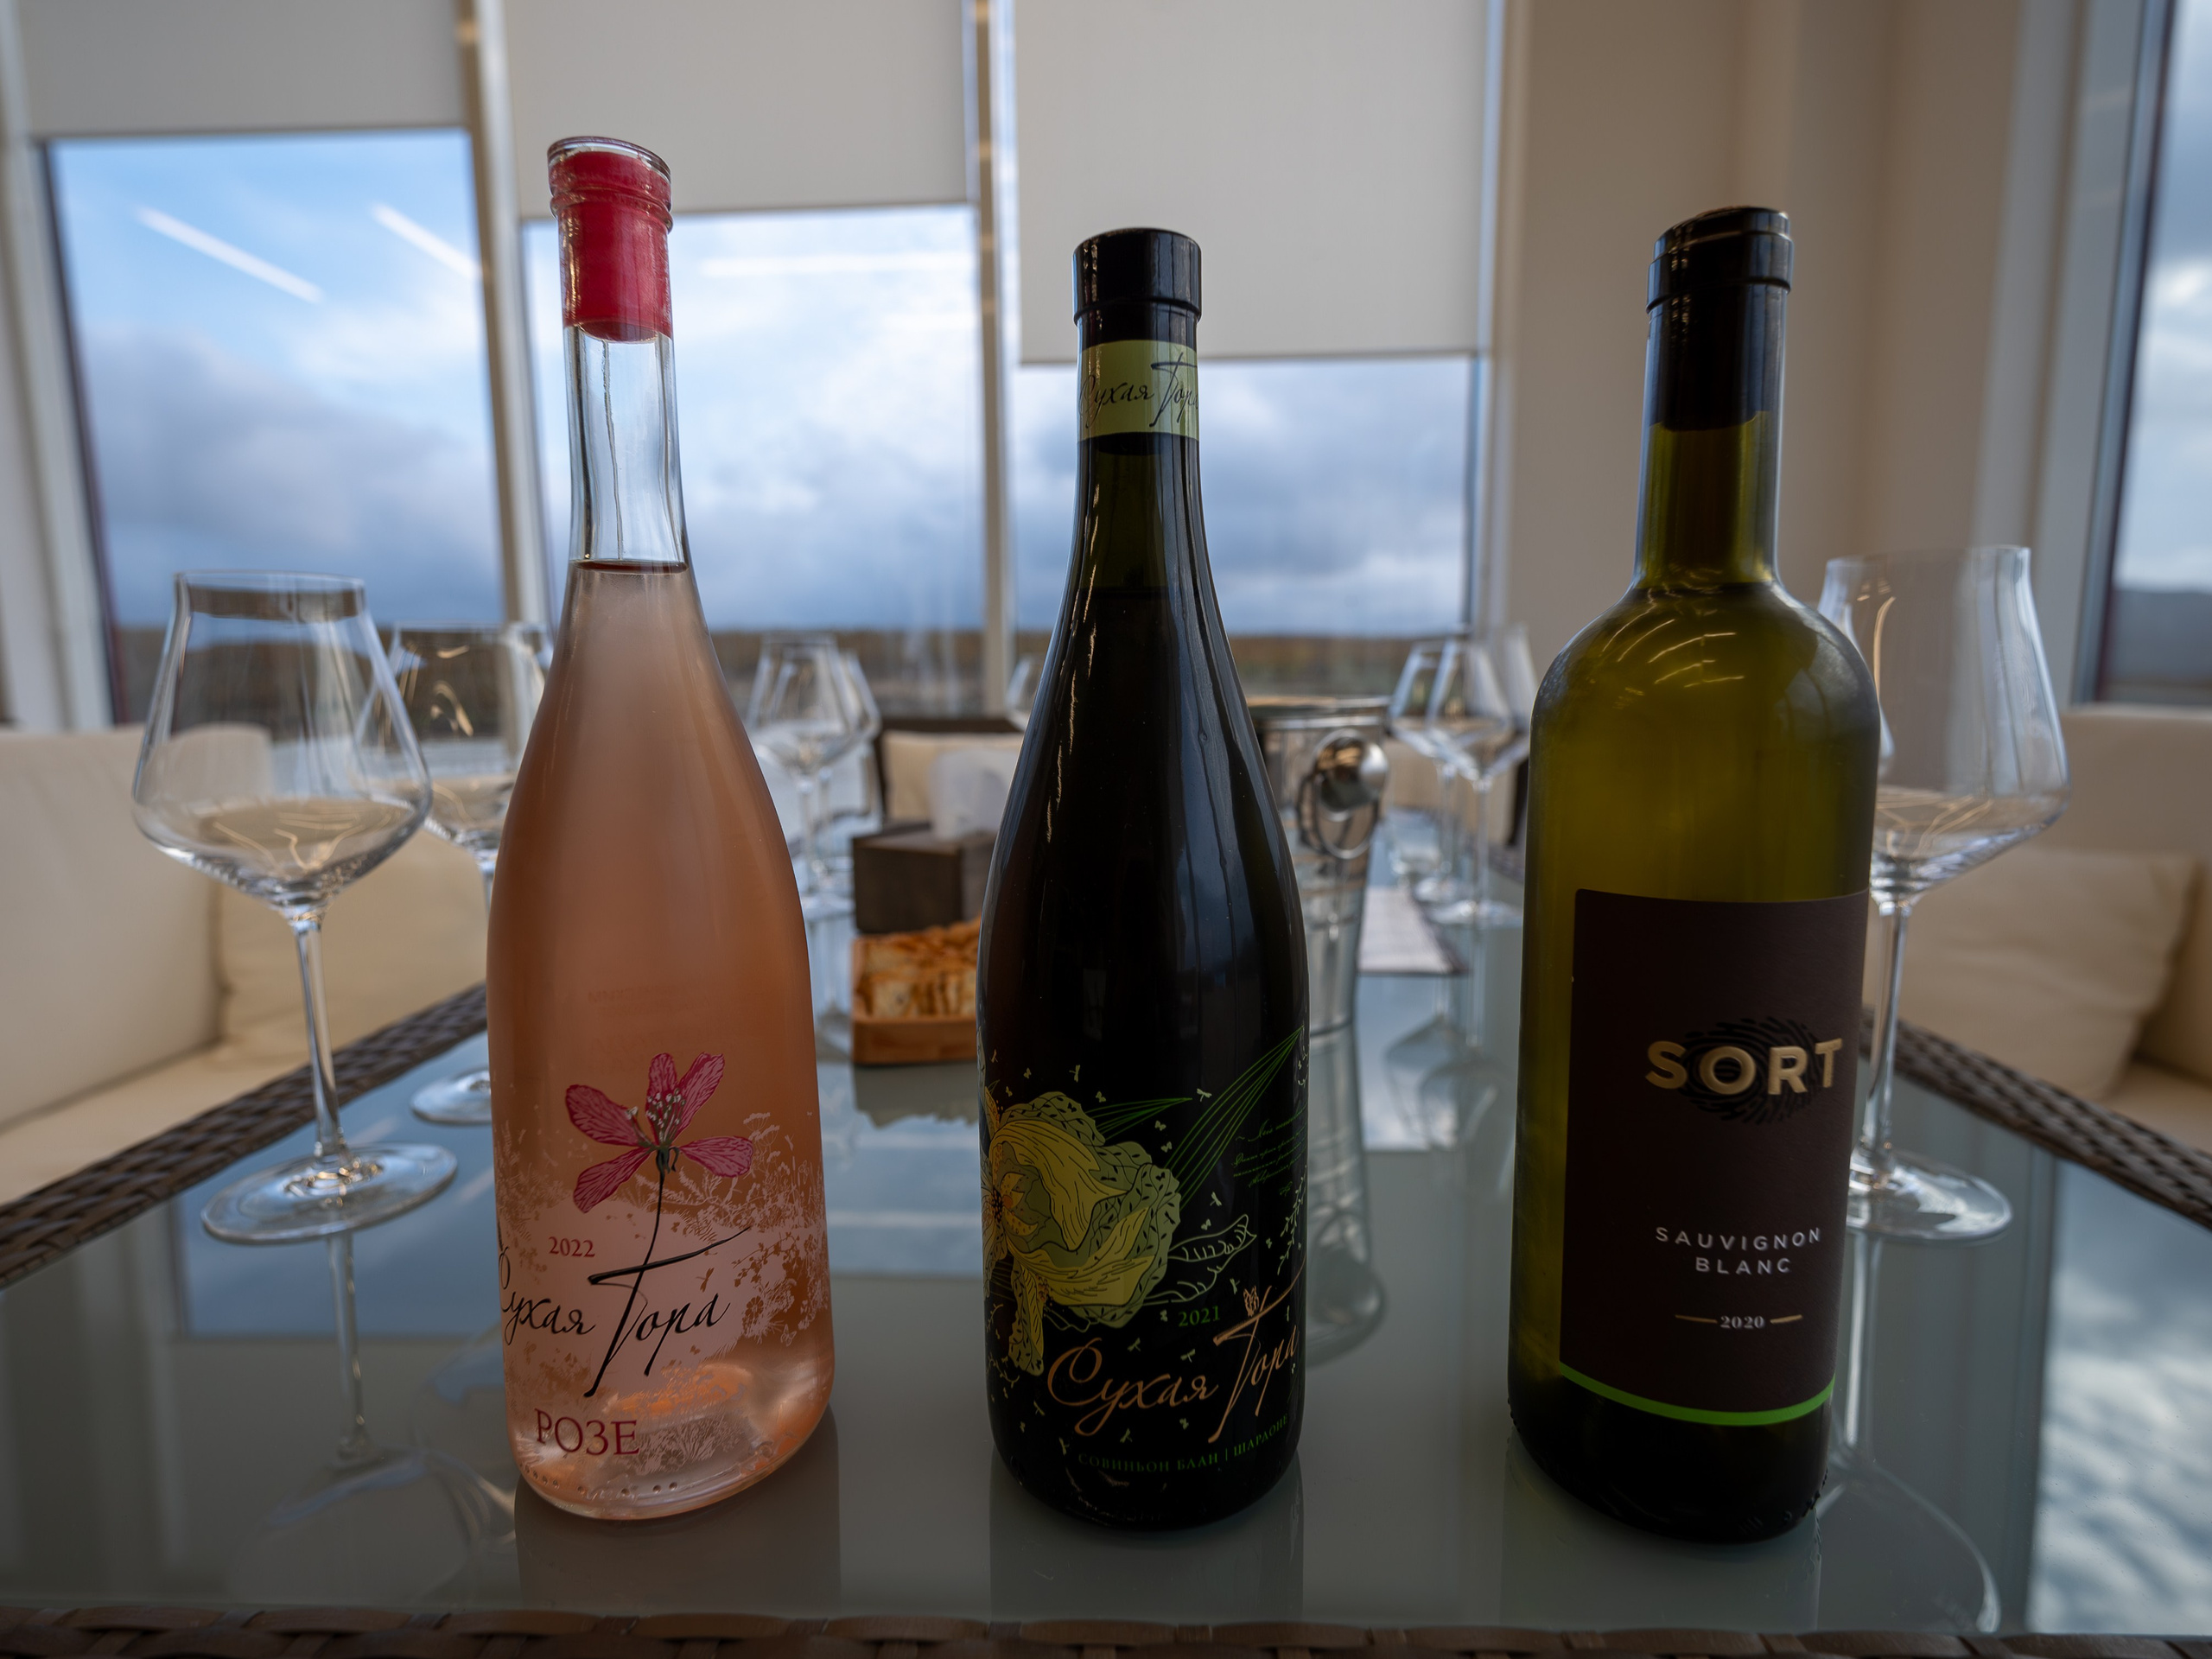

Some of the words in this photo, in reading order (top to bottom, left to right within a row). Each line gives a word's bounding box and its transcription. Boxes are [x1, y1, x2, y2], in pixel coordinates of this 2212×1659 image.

[1644, 1037, 1844, 1096] SORT
[549, 1236, 595, 1257] 2022
[1656, 1225, 1822, 1251] SAUVIGNON
[1694, 1256, 1791, 1274] BLANC
[1179, 1305, 1220, 1327] 2021
[1720, 1313, 1766, 1329] 2020
[1047, 1336, 1218, 1437] Сухая
[534, 1408, 641, 1457] РОЗЕ
[1078, 1452, 1170, 1473] СОВИНЬОН
[1177, 1452, 1219, 1471] БЛАН
[1234, 1413, 1290, 1458] ШАРДОНЕ
